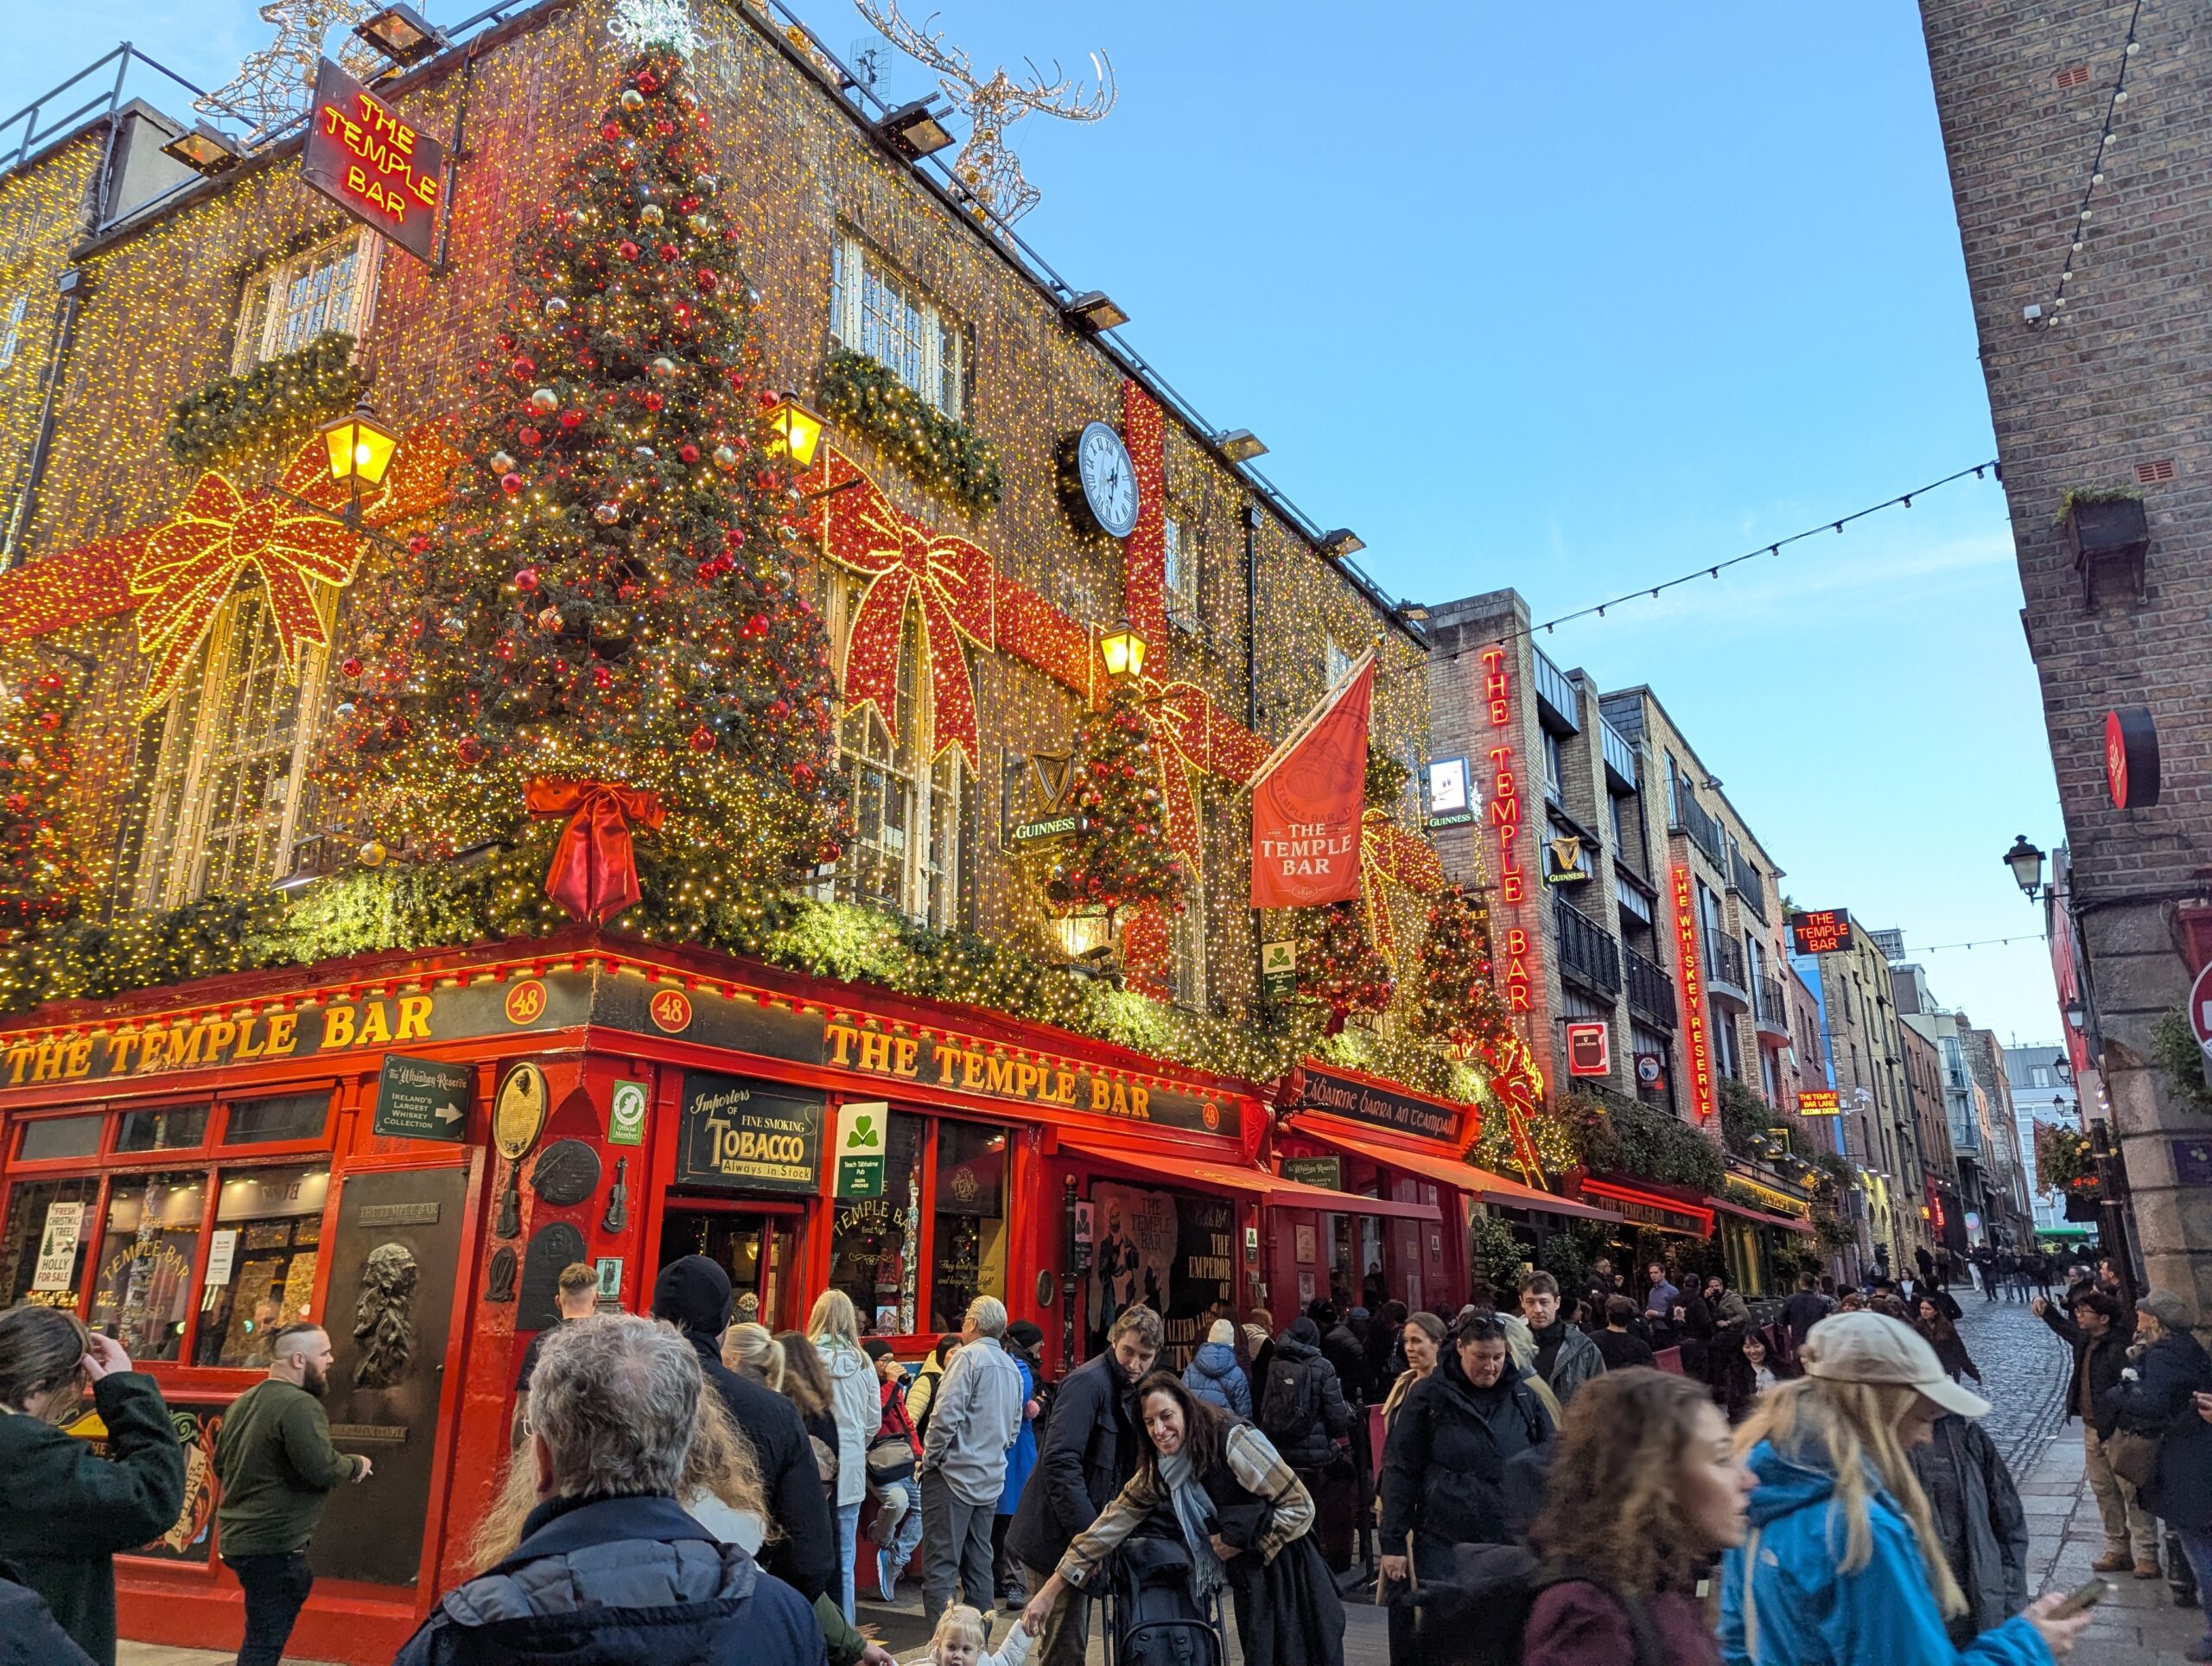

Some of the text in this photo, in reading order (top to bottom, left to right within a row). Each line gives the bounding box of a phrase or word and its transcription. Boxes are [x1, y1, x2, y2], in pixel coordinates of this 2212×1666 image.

[359, 94, 416, 154] THE
[325, 106, 437, 205] TEMPLE
[348, 166, 406, 222] BAR
[1483, 651, 1509, 723] THE
[1016, 817, 1075, 838] GUINNESS
[1429, 813, 1471, 827] GUINNESS
[1490, 747, 1523, 902] TEMPLE
[1287, 823, 1325, 838] THE
[1260, 834, 1352, 858] TEMPLE
[1281, 858, 1331, 876] BAR
[1549, 872, 1585, 882] GUINNESS
[1675, 869, 1688, 907] THE
[1807, 912, 1834, 925] THE
[1796, 924, 1848, 939] TEMPLE
[1810, 938, 1838, 951] BAR
[1507, 930, 1529, 1010] BAR
[1679, 915, 1699, 1008] WHISKEY
[512, 989, 538, 1016] 48
[658, 995, 683, 1022] 48
[7, 995, 433, 1084] THE TEMPLE BAR
[826, 1024, 1149, 1118] THE TEMPLE BAR
[1692, 1017, 1711, 1114] RESERVE
[388, 1065, 467, 1091] The Whiskey Reserve
[391, 1093, 433, 1104] IRELAND'S
[394, 1102, 429, 1112] LARGEST
[690, 1089, 750, 1117] Importers
[391, 1110, 428, 1120] WHISKEY
[727, 1106, 738, 1115] OF
[384, 1117, 433, 1129] COLLECTION
[741, 1115, 805, 1133] FINE SMOKING
[615, 1131, 639, 1140] Member
[705, 1117, 804, 1167] TOBACCO
[723, 1161, 810, 1180] Always in Stock
[380, 1205, 416, 1217] TEMPLE
[417, 1203, 438, 1214] BAR
[1141, 1198, 1161, 1215] THE
[833, 1200, 889, 1237] TEMPLE
[1131, 1214, 1171, 1234] TEMPLE
[55, 1227, 74, 1237] TREES
[1141, 1232, 1162, 1251] BAR
[1211, 1234, 1230, 1256] THE
[41, 1259, 69, 1270] HOLLY
[103, 1240, 162, 1281] TEMPLE
[164, 1245, 189, 1283] BAR
[1189, 1256, 1230, 1280] EMPEROR
[37, 1272, 69, 1282] FOR SALE
[1219, 1281, 1230, 1300] OF
